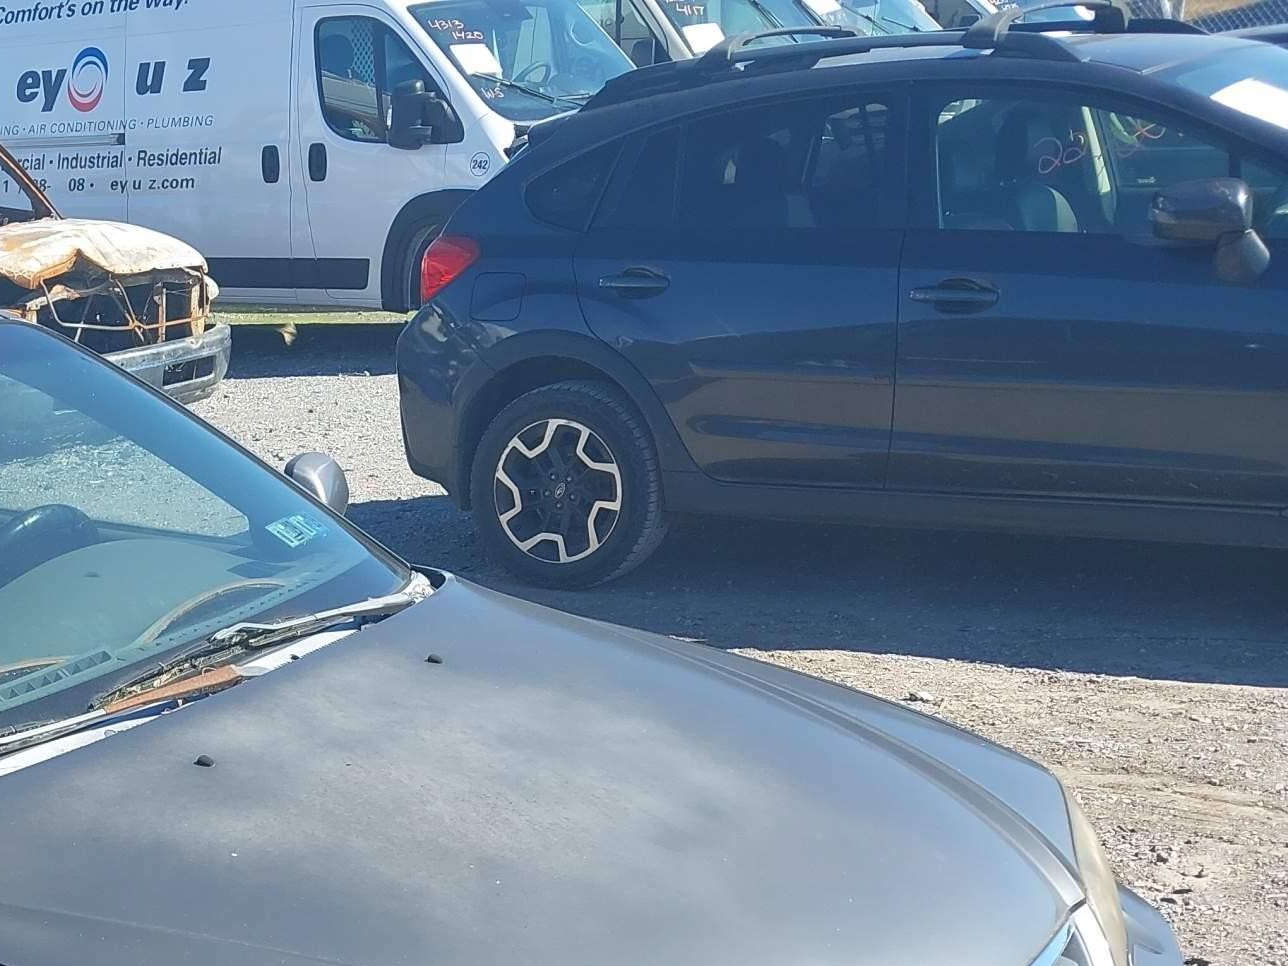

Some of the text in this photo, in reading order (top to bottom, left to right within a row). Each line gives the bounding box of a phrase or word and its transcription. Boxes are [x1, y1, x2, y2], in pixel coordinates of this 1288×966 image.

[81, 0, 104, 16] on
[27, 123, 47, 135] AIR
[50, 119, 137, 134] CONDITIONING
[146, 114, 214, 129] PLUMBING
[56, 150, 124, 171] Industrial
[136, 146, 222, 168] Residential
[472, 159, 488, 170] 242
